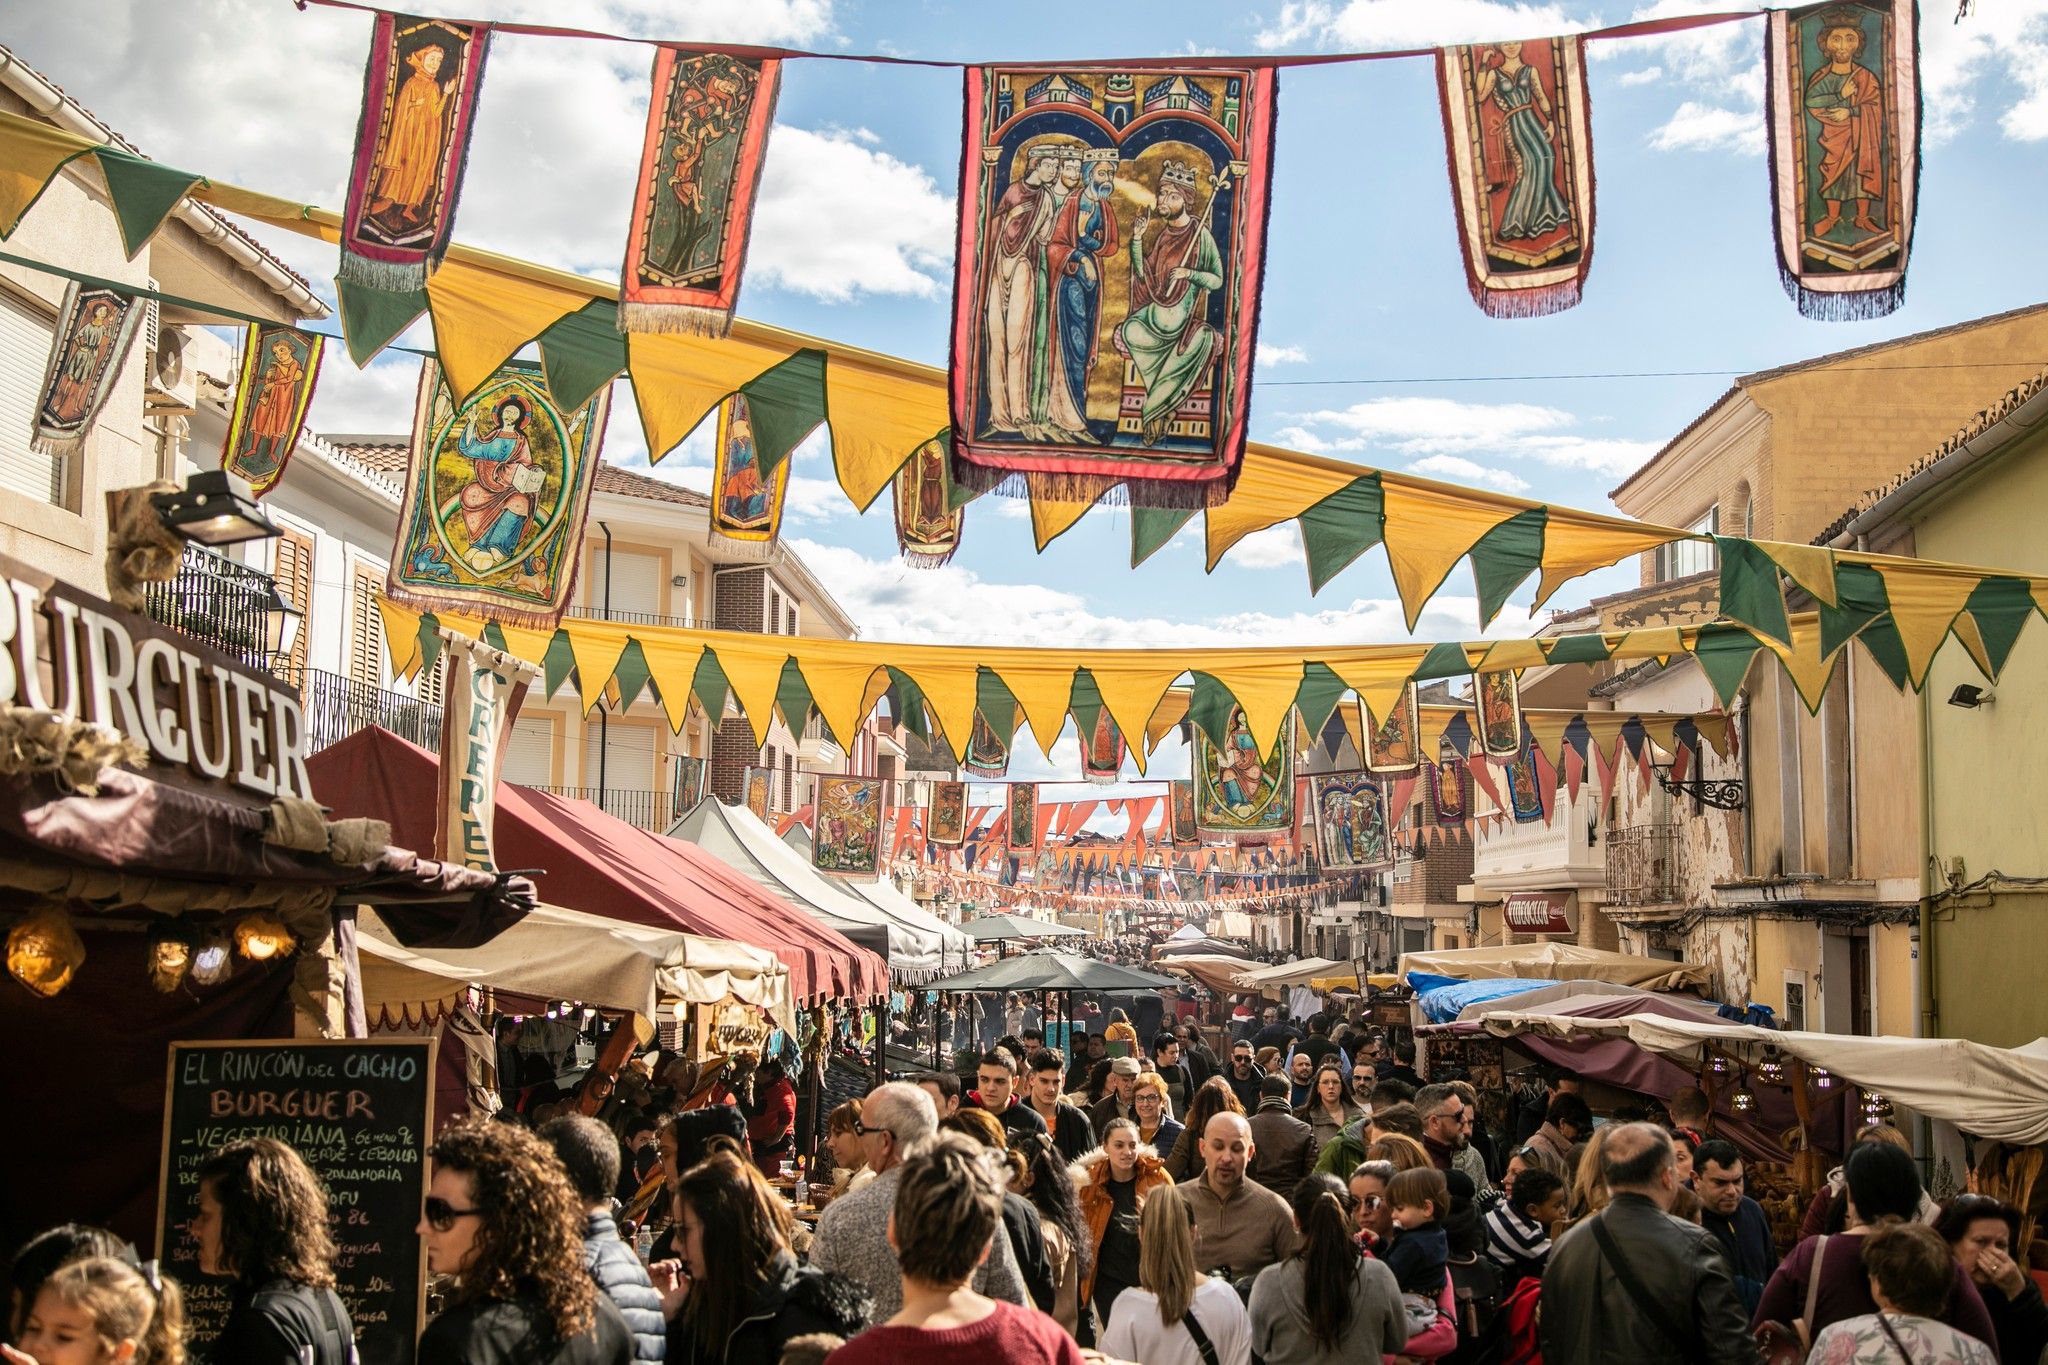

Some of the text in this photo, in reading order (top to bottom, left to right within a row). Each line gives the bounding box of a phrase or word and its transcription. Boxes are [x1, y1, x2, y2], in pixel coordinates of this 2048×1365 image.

[1508, 901, 1549, 925] VIDEOCLUB
[183, 1050, 417, 1085] EL RINCÓN DEL CACHO
[210, 1088, 375, 1120] BURGUER
[359, 1146, 418, 1163] CEBOLLA
[329, 1191, 360, 1205] OFU
